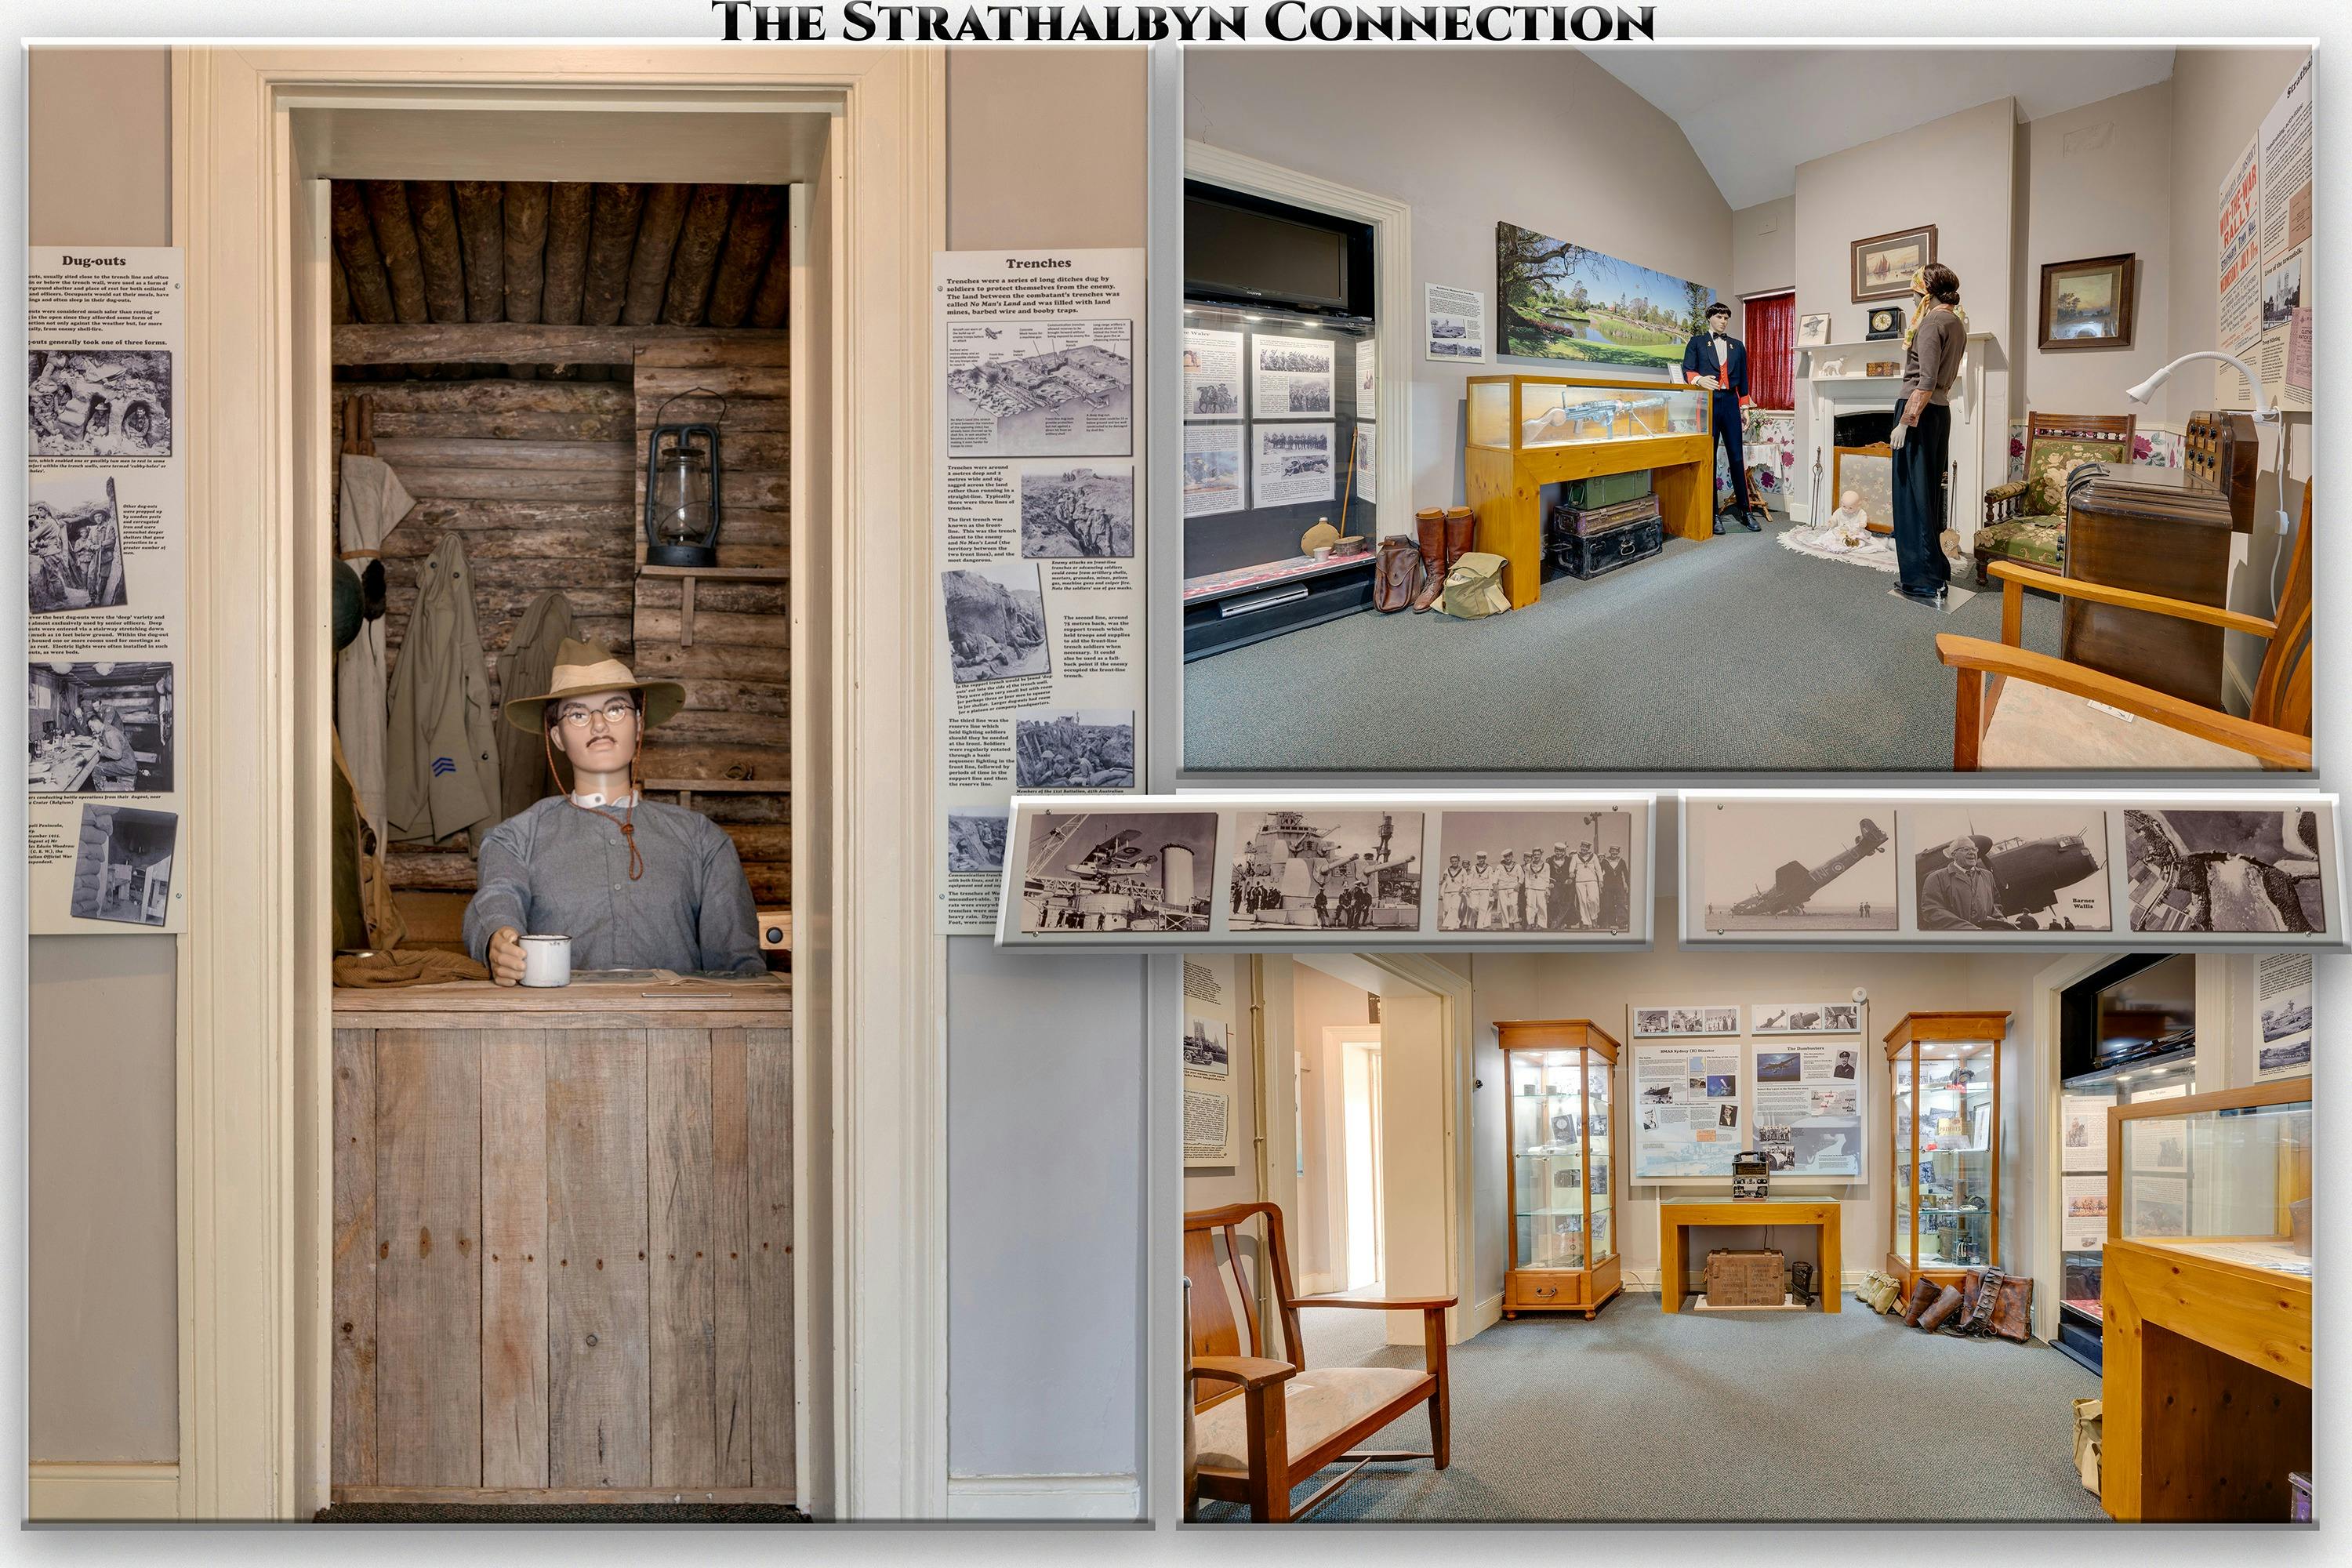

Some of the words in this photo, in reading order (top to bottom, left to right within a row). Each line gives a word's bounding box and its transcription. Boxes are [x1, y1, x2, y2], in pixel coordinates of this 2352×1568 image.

[2220, 164, 2256, 238] WIN-THE-WAR
[62, 256, 125, 268] Dug-outs
[1006, 258, 1071, 268] Trenches
